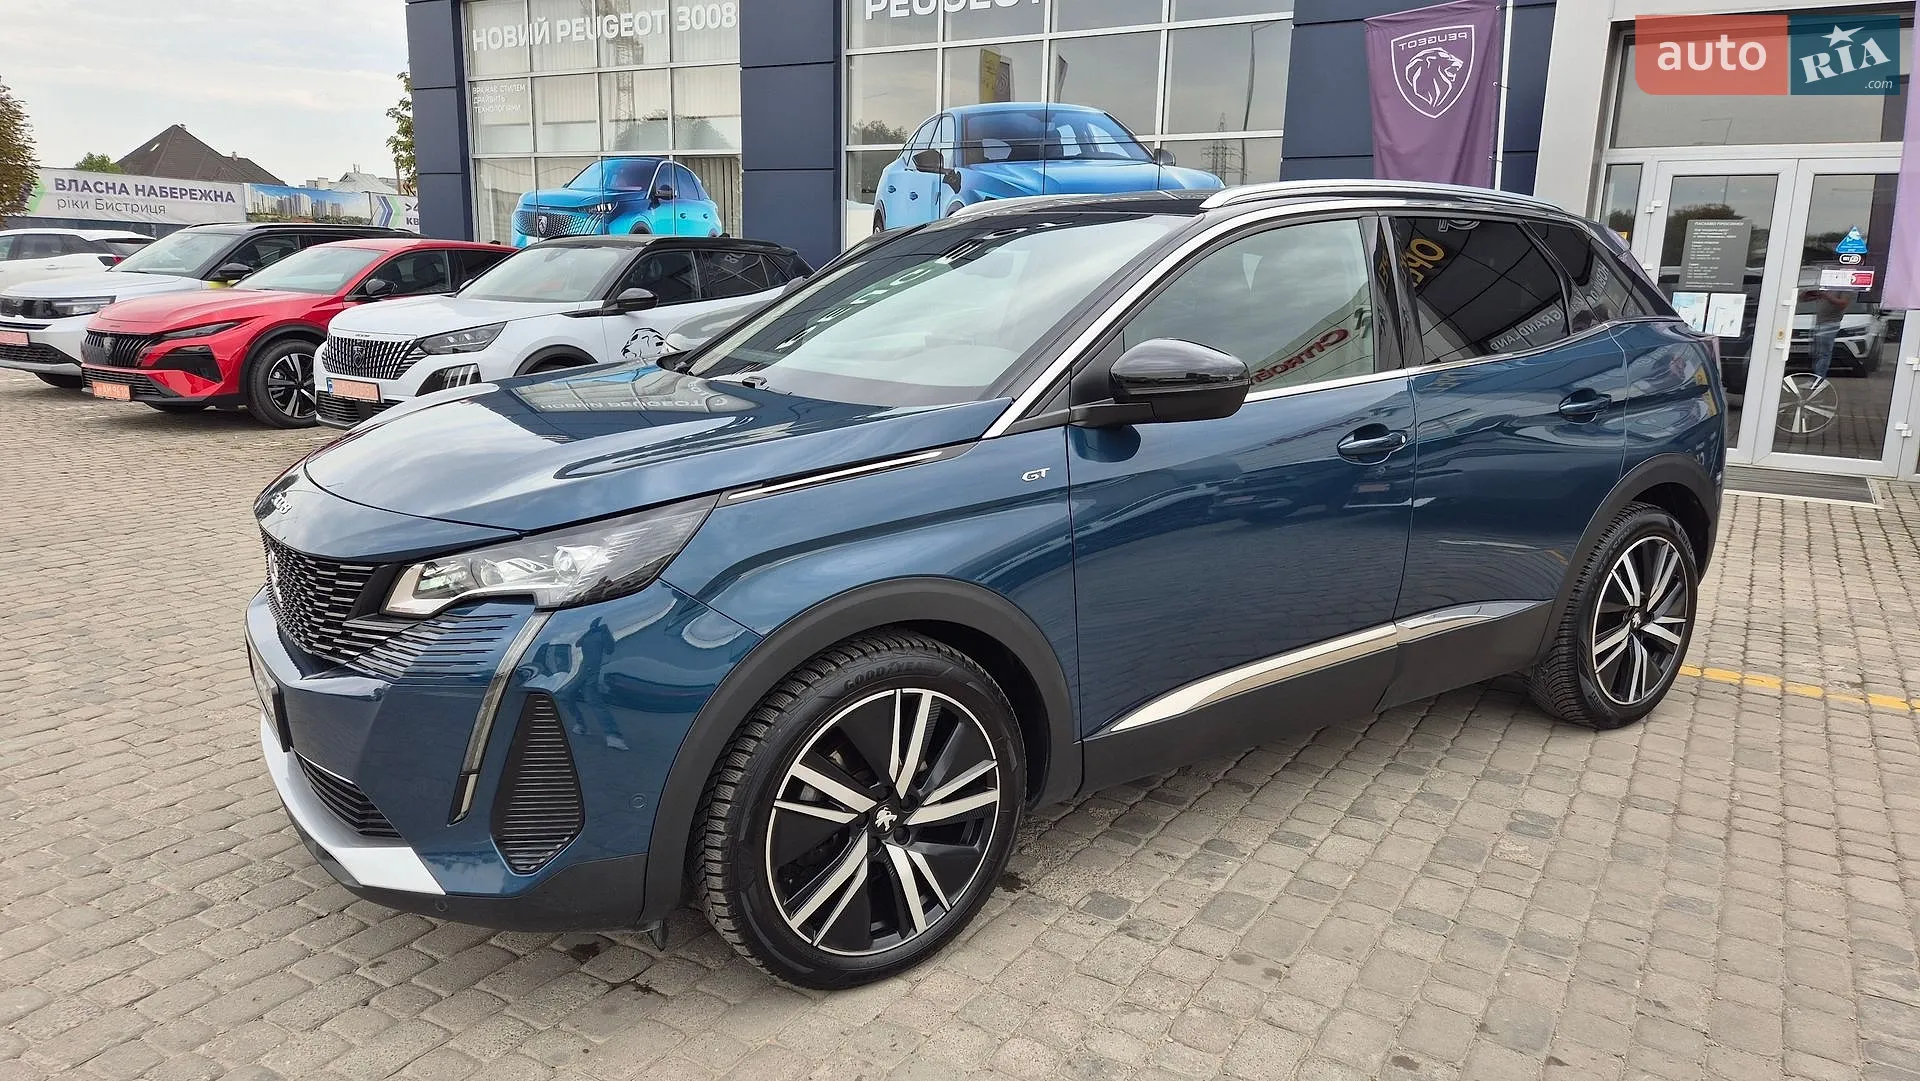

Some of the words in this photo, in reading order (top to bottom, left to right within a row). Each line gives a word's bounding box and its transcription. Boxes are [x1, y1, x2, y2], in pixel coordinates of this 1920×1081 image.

[472, 16, 551, 52] НОВИЙ
[556, 9, 668, 43] PEUGEOT
[676, 2, 737, 32] 3008
[55, 178, 130, 195] ВЛАСНА
[134, 184, 236, 203] НАБЕРЕЖНА
[57, 195, 89, 210] ріки
[95, 198, 166, 214] Бистриця
[1021, 467, 1051, 482] GT
